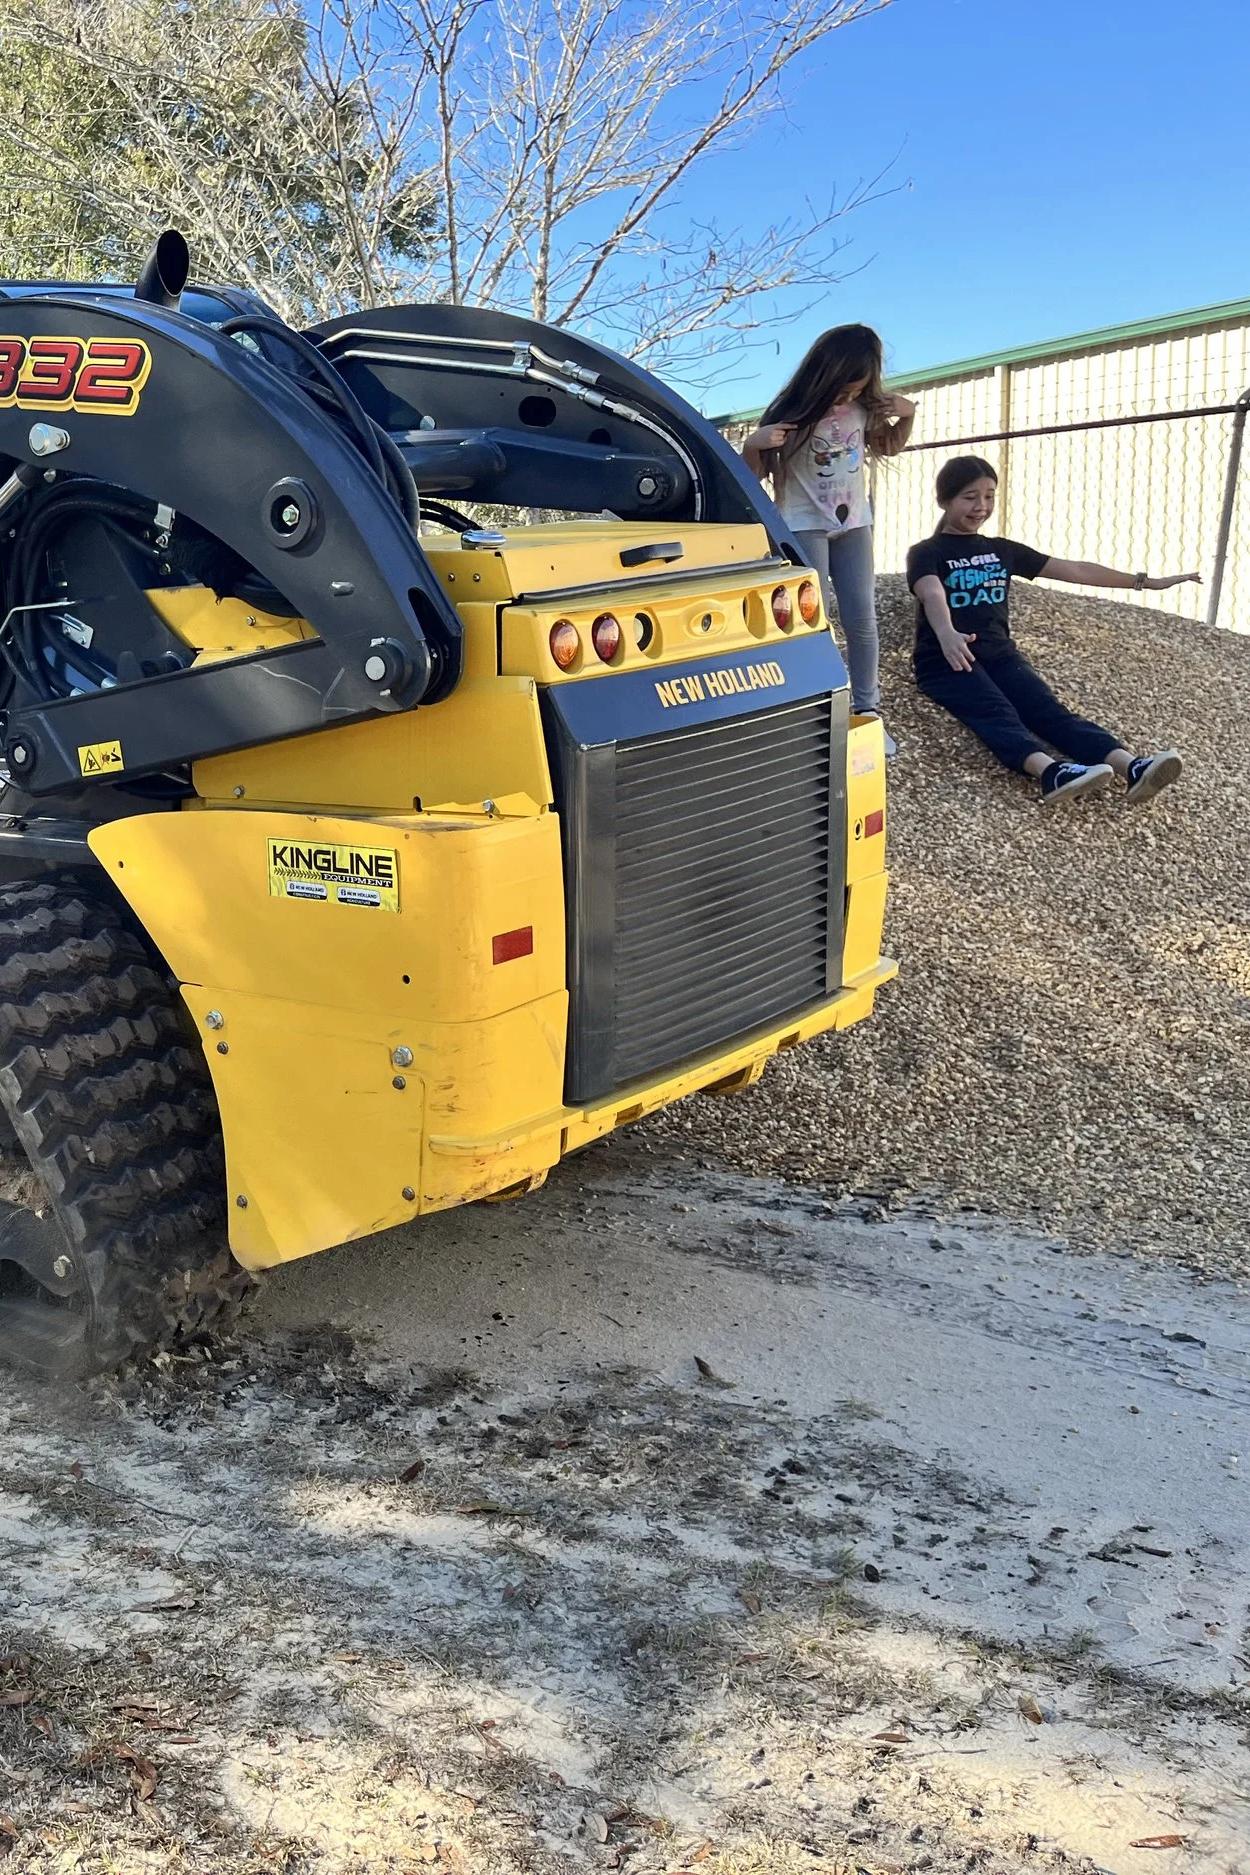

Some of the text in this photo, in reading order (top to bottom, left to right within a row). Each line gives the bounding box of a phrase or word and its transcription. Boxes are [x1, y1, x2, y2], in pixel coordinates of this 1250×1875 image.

[970, 553, 1001, 566] GIRL
[950, 587, 1005, 608] DAD
[654, 661, 786, 708] NEW HOLLAND
[272, 845, 393, 879] KINGLINE
[322, 872, 392, 888] EQUIPMENT
